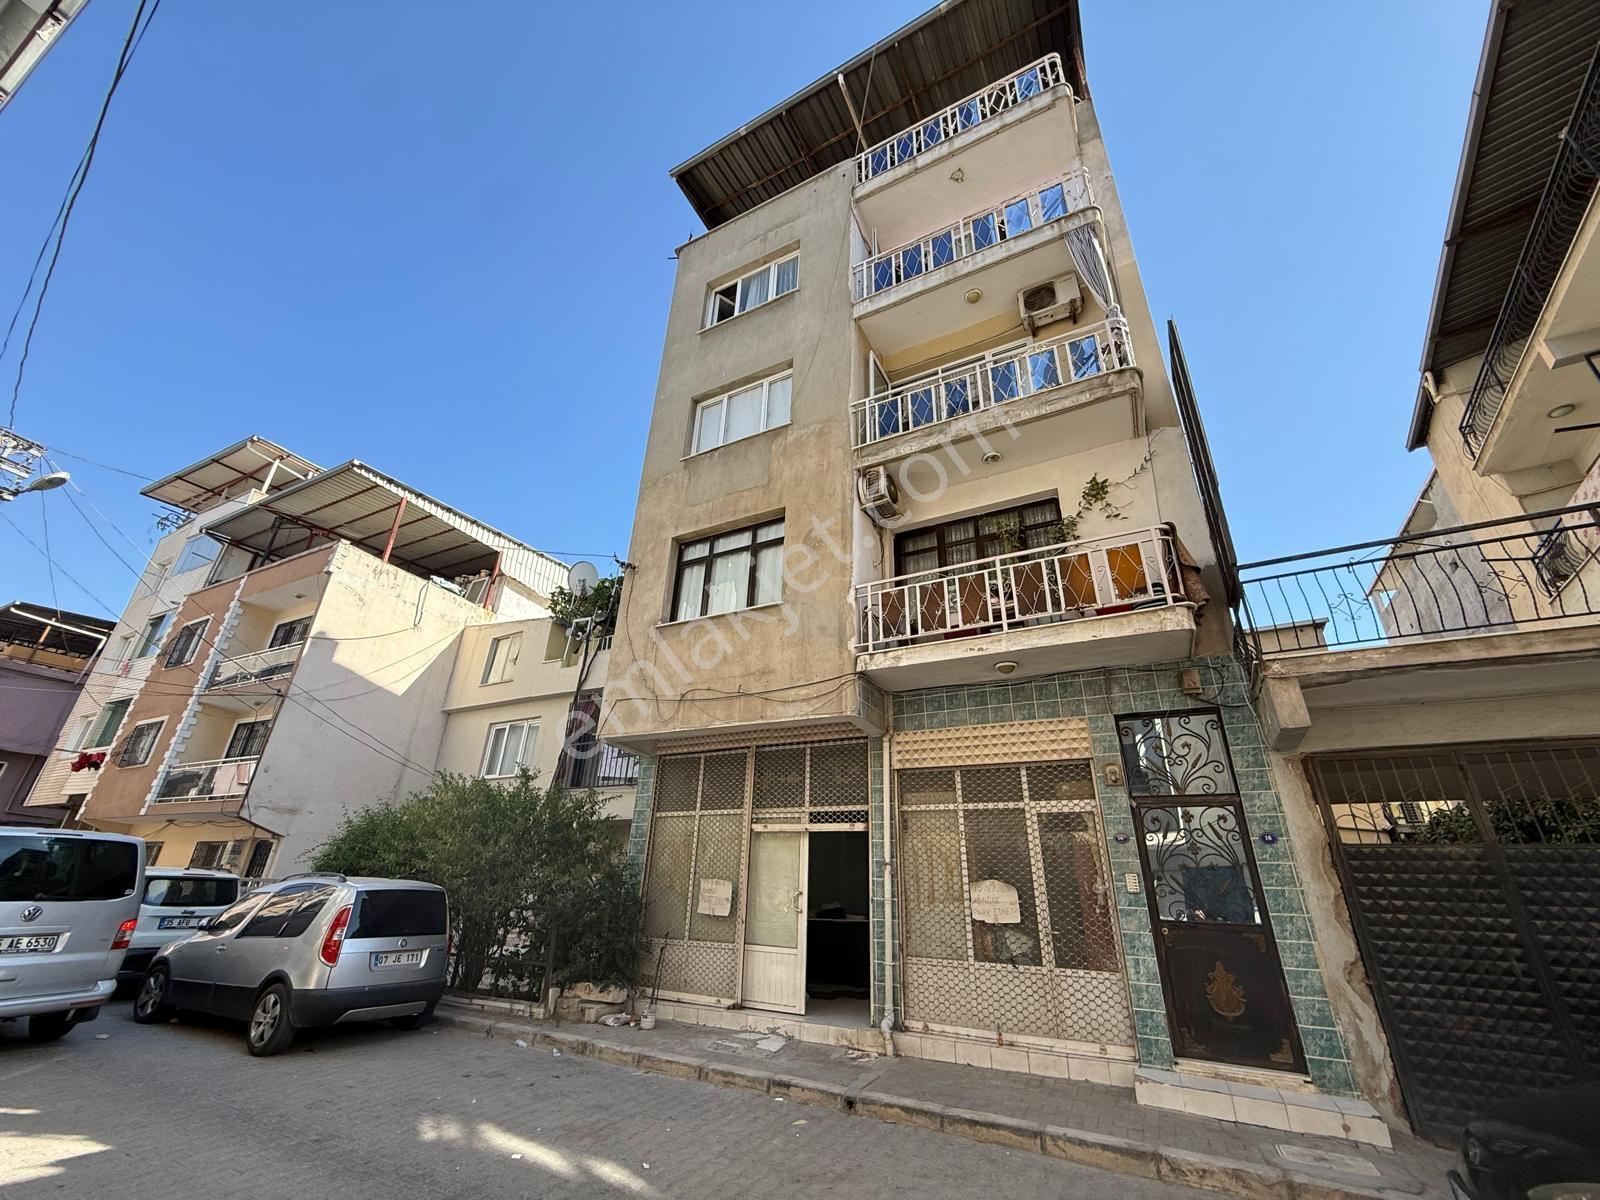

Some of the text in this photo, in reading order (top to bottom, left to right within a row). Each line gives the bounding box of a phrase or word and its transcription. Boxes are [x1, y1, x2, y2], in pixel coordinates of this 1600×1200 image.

[7, 938, 23, 949] AE
[26, 936, 56, 948] 6530
[379, 953, 419, 964] 07 JE 171
